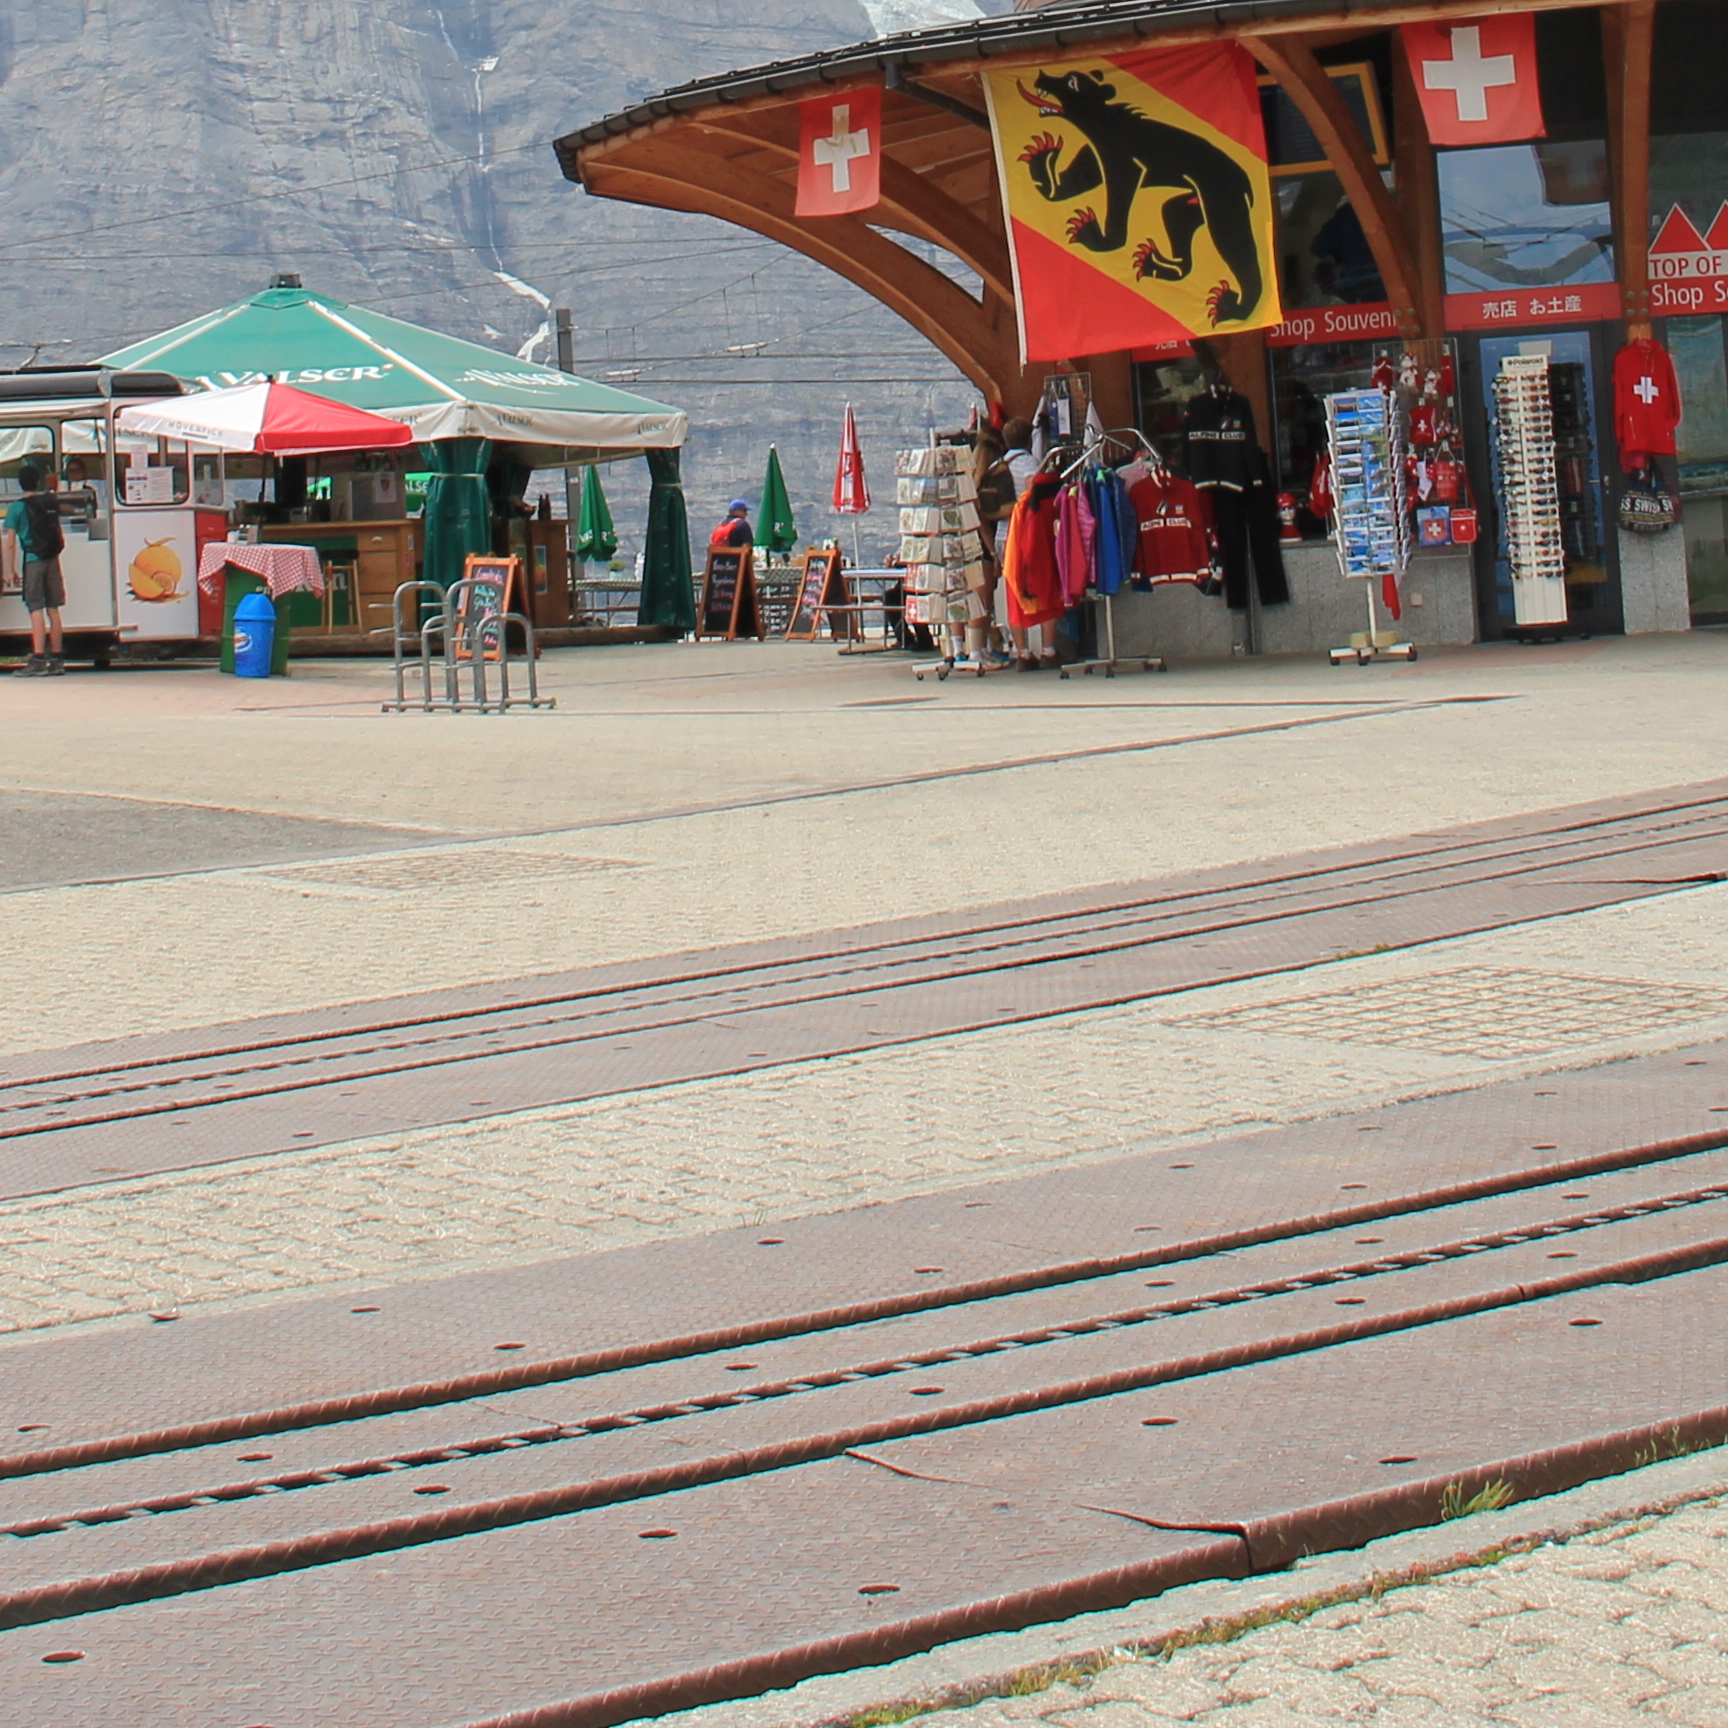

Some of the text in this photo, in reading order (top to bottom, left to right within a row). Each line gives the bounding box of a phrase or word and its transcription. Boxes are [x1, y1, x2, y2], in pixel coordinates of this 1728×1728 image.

[1649, 257, 1690, 278] TOP
[1696, 254, 1722, 275] OF
[1482, 295, 1582, 320] 売店 お土産
[1651, 282, 1704, 309] Shop
